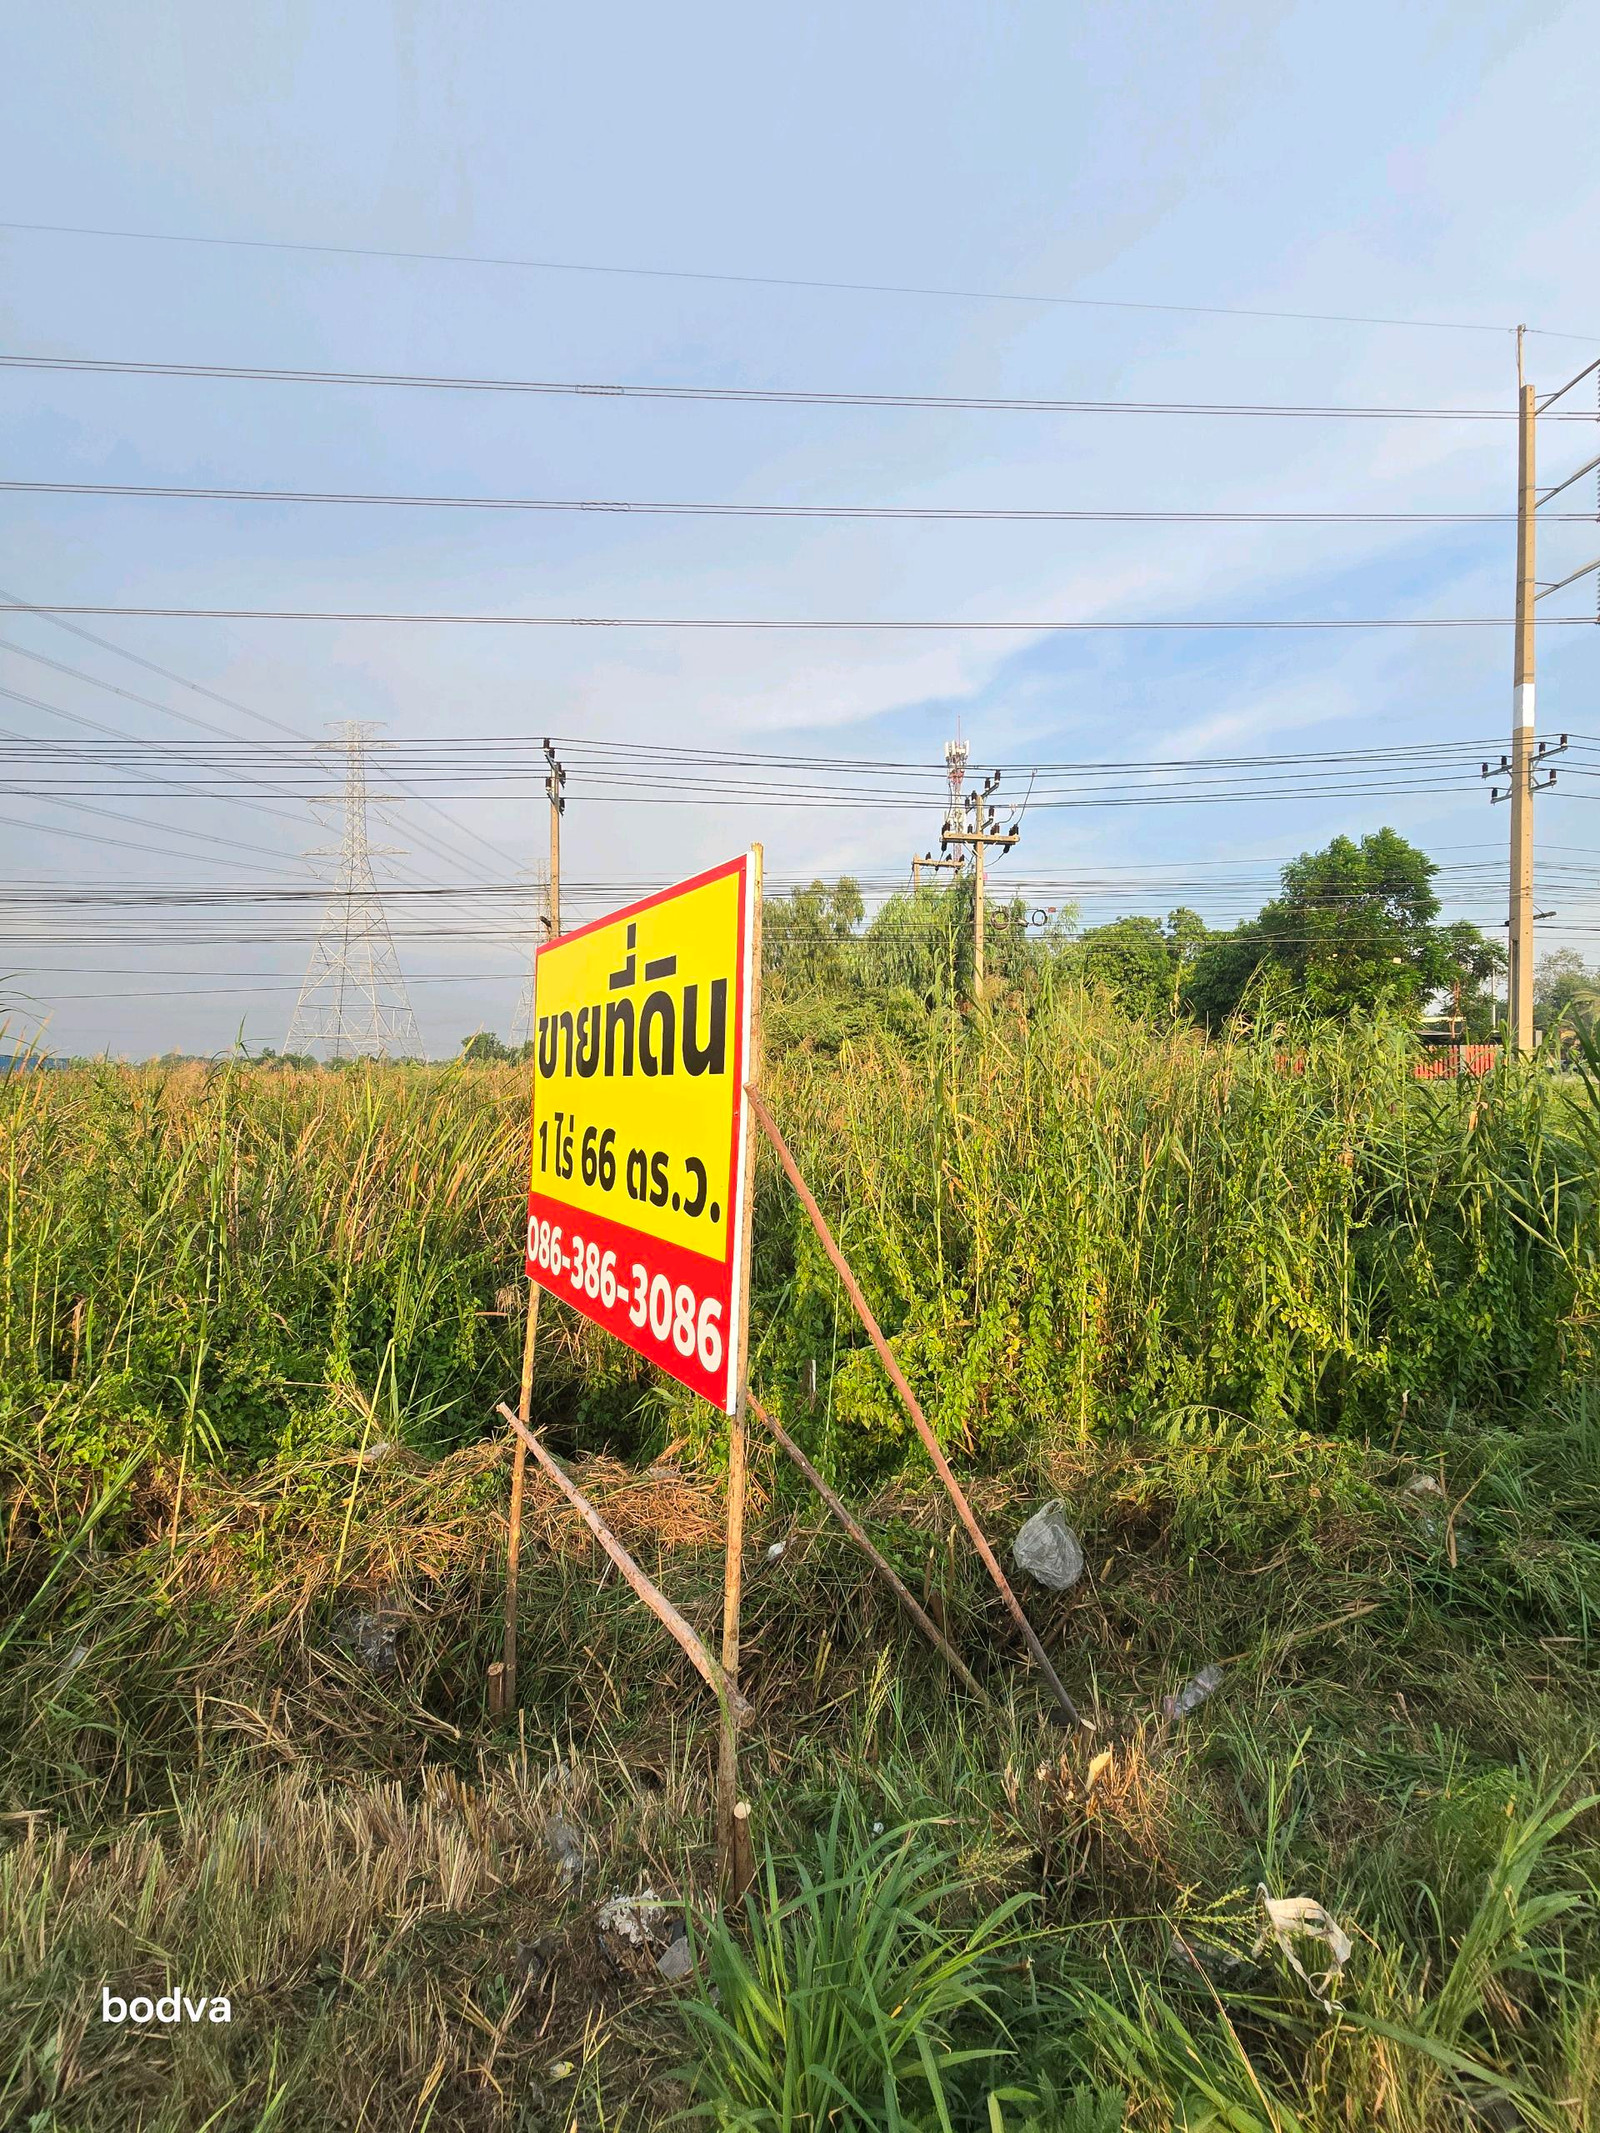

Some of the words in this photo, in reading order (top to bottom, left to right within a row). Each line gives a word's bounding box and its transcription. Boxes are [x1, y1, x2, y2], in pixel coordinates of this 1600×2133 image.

[538, 922, 728, 1079] ขายที่ดิน
[539, 1121, 549, 1173] 1
[554, 1112, 575, 1181] ไร่
[581, 1126, 617, 1192] 66
[626, 1147, 721, 1224] ตร.ว.
[527, 1215, 723, 1373] 086-386-3086
